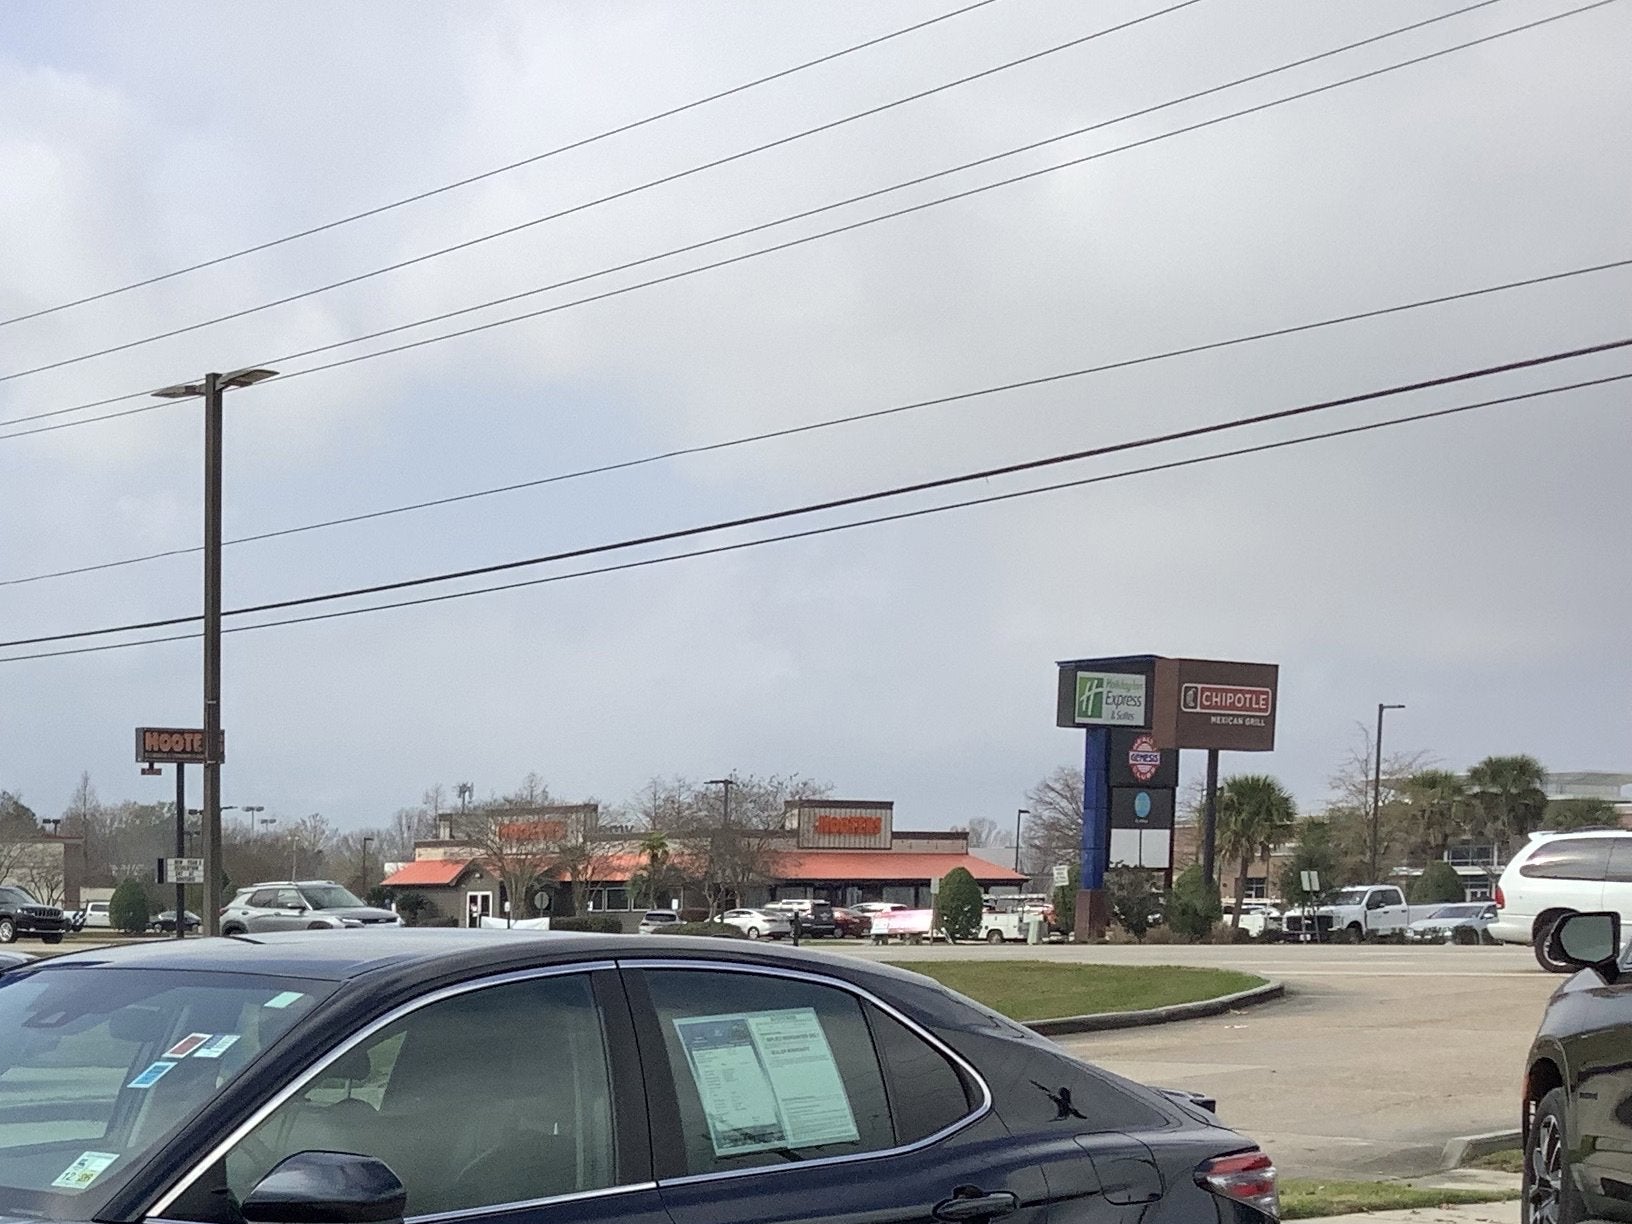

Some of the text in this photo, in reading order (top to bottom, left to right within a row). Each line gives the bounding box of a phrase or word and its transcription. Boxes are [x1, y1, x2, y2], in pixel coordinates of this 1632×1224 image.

[1105, 690, 1142, 709] Express
[1202, 692, 1268, 708] CHIPOTLE
[1211, 716, 1266, 727] MEXICAN GRILL
